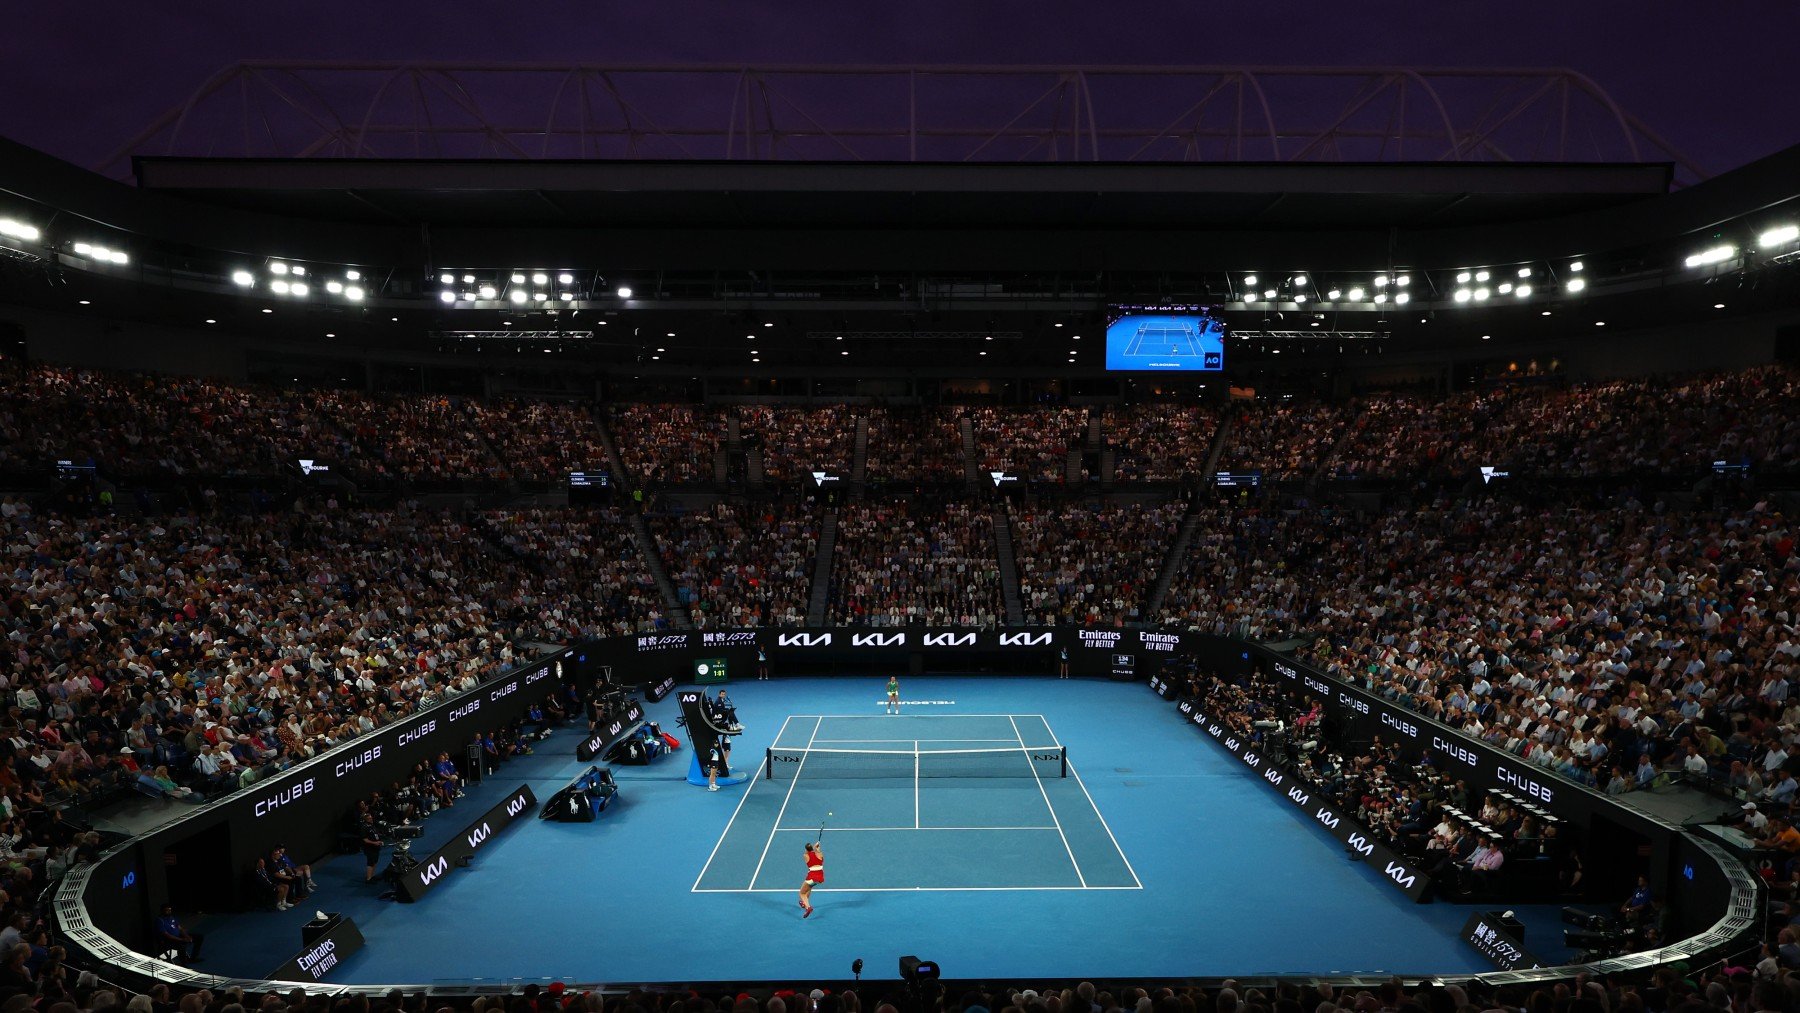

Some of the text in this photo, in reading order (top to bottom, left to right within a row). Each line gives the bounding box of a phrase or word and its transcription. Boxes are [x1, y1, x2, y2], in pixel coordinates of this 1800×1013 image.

[779, 633, 831, 645] KIA
[853, 633, 904, 645] KIA
[924, 633, 976, 645] KIA
[1000, 633, 1052, 645] KIA
[1079, 630, 1121, 640] Emirates
[1140, 632, 1179, 644] Emirates
[1085, 640, 1115, 648] FLY BETTER
[1145, 642, 1174, 651] FLY BETTER
[526, 667, 548, 684] CHUBB
[1275, 662, 1296, 679] CHUBB
[491, 682, 517, 701] CHUBB
[1304, 676, 1329, 696] CHUBB
[683, 695, 697, 703] AO
[1180, 701, 1192, 714] KIA
[1340, 693, 1369, 715] CHUBB
[449, 700, 480, 722] CHUBB
[628, 708, 639, 721] KIA
[1193, 712, 1206, 725] KIA
[399, 720, 436, 746] CHUBB
[610, 721, 622, 735] KIA
[1208, 724, 1222, 738] KIA
[1381, 712, 1418, 738] CHUBB
[589, 736, 603, 752] KIA
[1225, 737, 1239, 751] KIA
[1433, 737, 1478, 766] CHUBB
[336, 746, 382, 777] CHUBB
[1244, 751, 1260, 767] KIA
[1265, 768, 1283, 786] KIA
[1497, 766, 1553, 803] CHUBB
[255, 779, 315, 817] CHUBB
[1289, 786, 1309, 806] KIA
[507, 795, 526, 816] KIA
[1317, 808, 1339, 829] KIA
[468, 823, 491, 847] KIA
[1348, 832, 1374, 856] KIA
[421, 856, 448, 885] KIA
[1385, 861, 1415, 888] KIA
[122, 872, 135, 889] AO
[297, 938, 335, 972] Emirates
[311, 952, 338, 979] FLY BETTER
